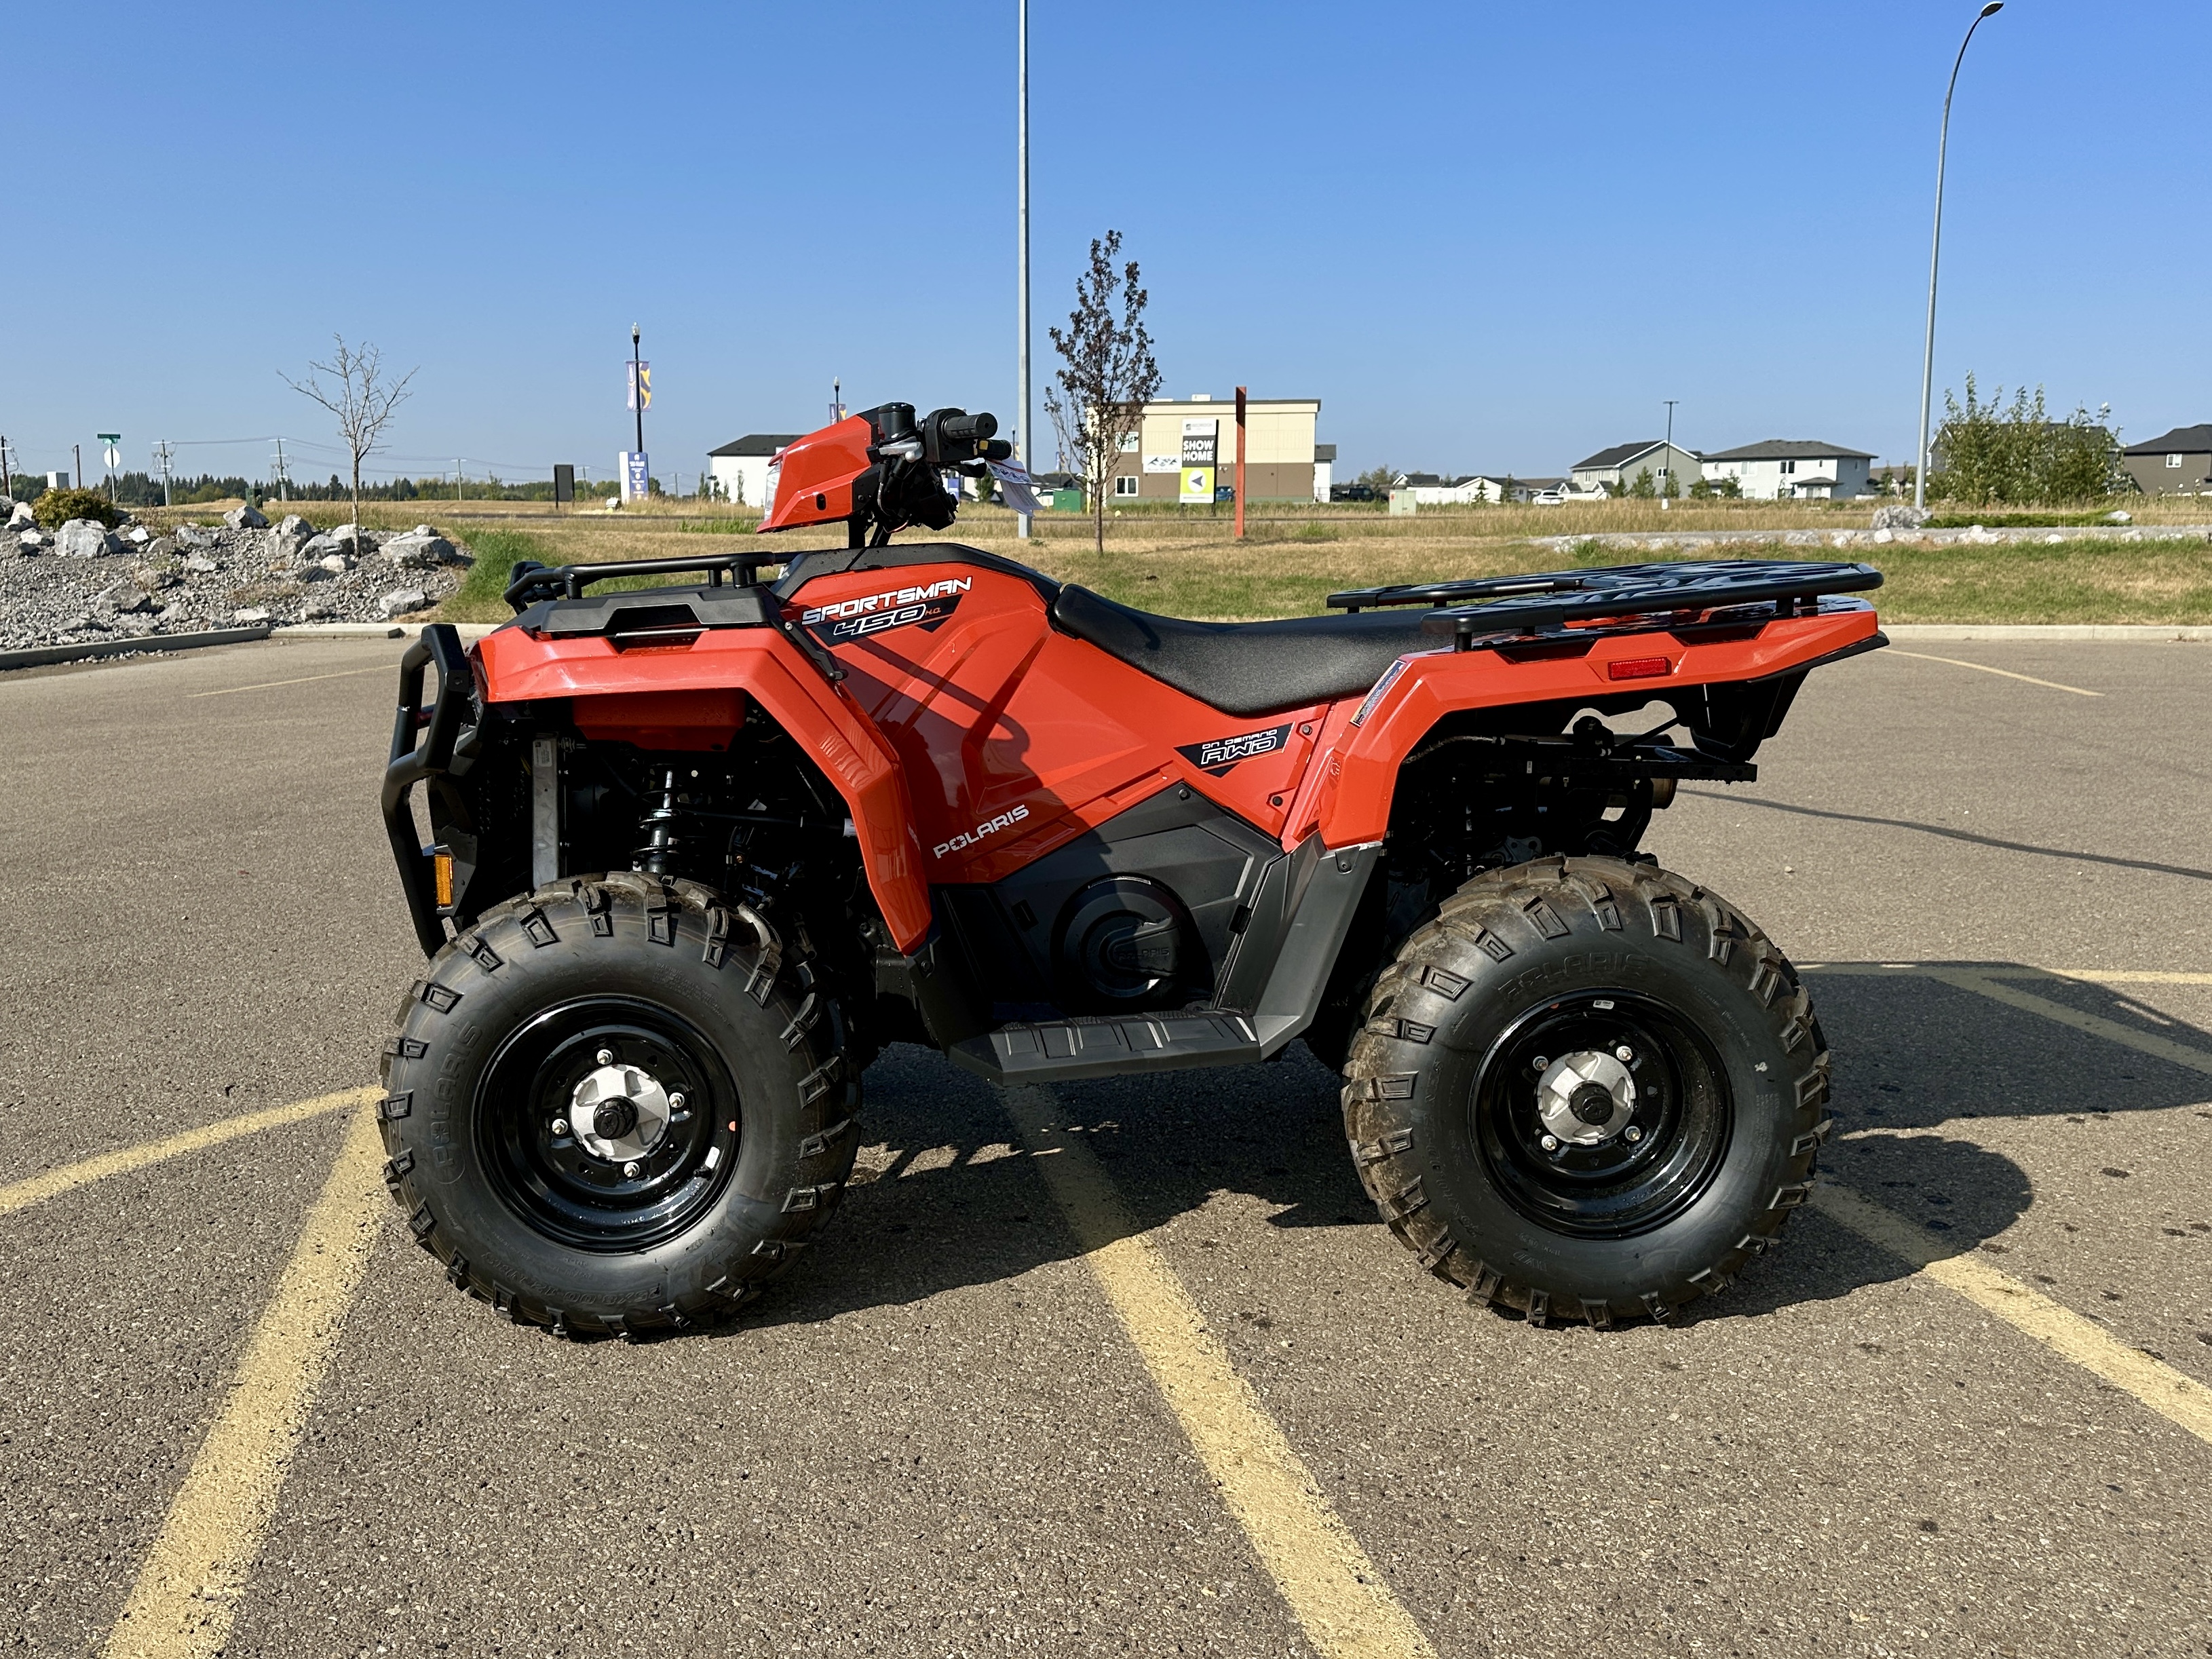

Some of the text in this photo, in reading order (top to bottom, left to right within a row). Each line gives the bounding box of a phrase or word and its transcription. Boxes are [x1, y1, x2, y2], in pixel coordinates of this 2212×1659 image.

[1183, 440, 1214, 451] SHOW
[1183, 451, 1213, 461] HOME
[801, 576, 972, 626] SPORTSMAN
[833, 603, 927, 636] 450
[1200, 736, 1278, 765] AWD
[1225, 729, 1278, 746] DEMAND
[933, 804, 1029, 859] POLARIS
[432, 1023, 484, 1169] POLARIS
